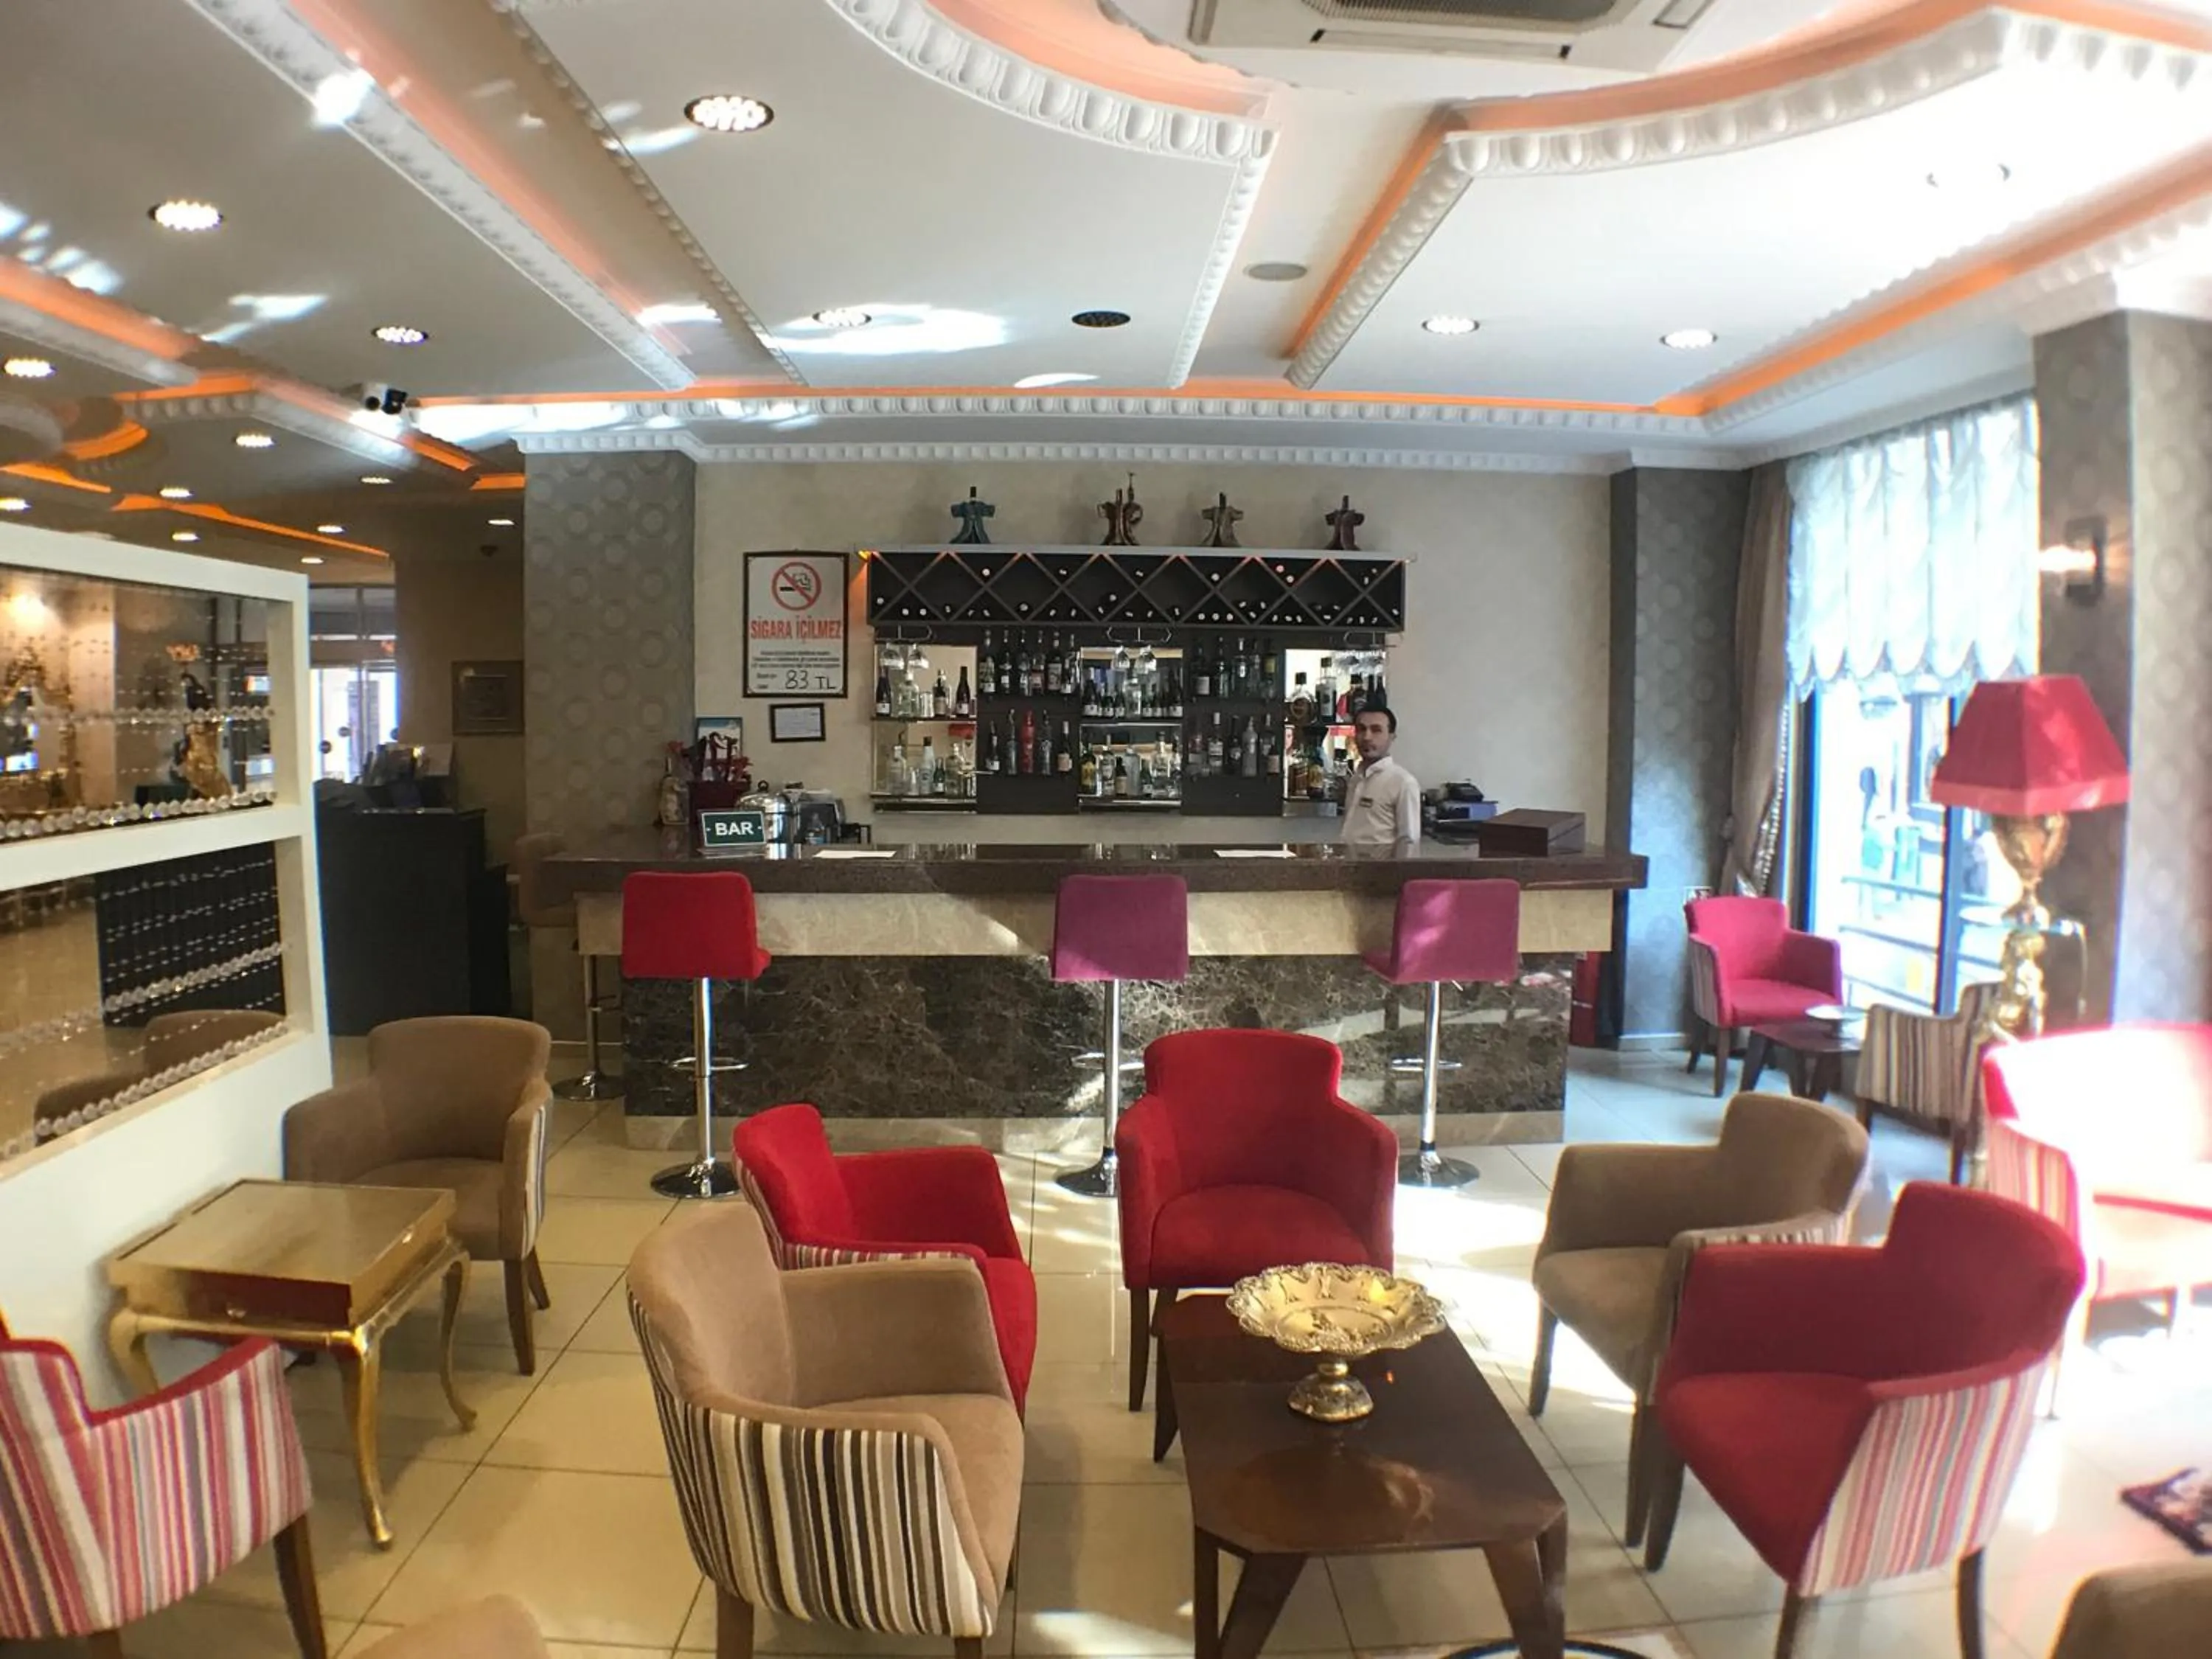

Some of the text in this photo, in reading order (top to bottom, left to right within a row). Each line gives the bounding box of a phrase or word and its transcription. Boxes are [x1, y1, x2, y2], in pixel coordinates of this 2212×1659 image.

[785, 669, 835, 689] 83 TL
[714, 821, 754, 836] BAR
